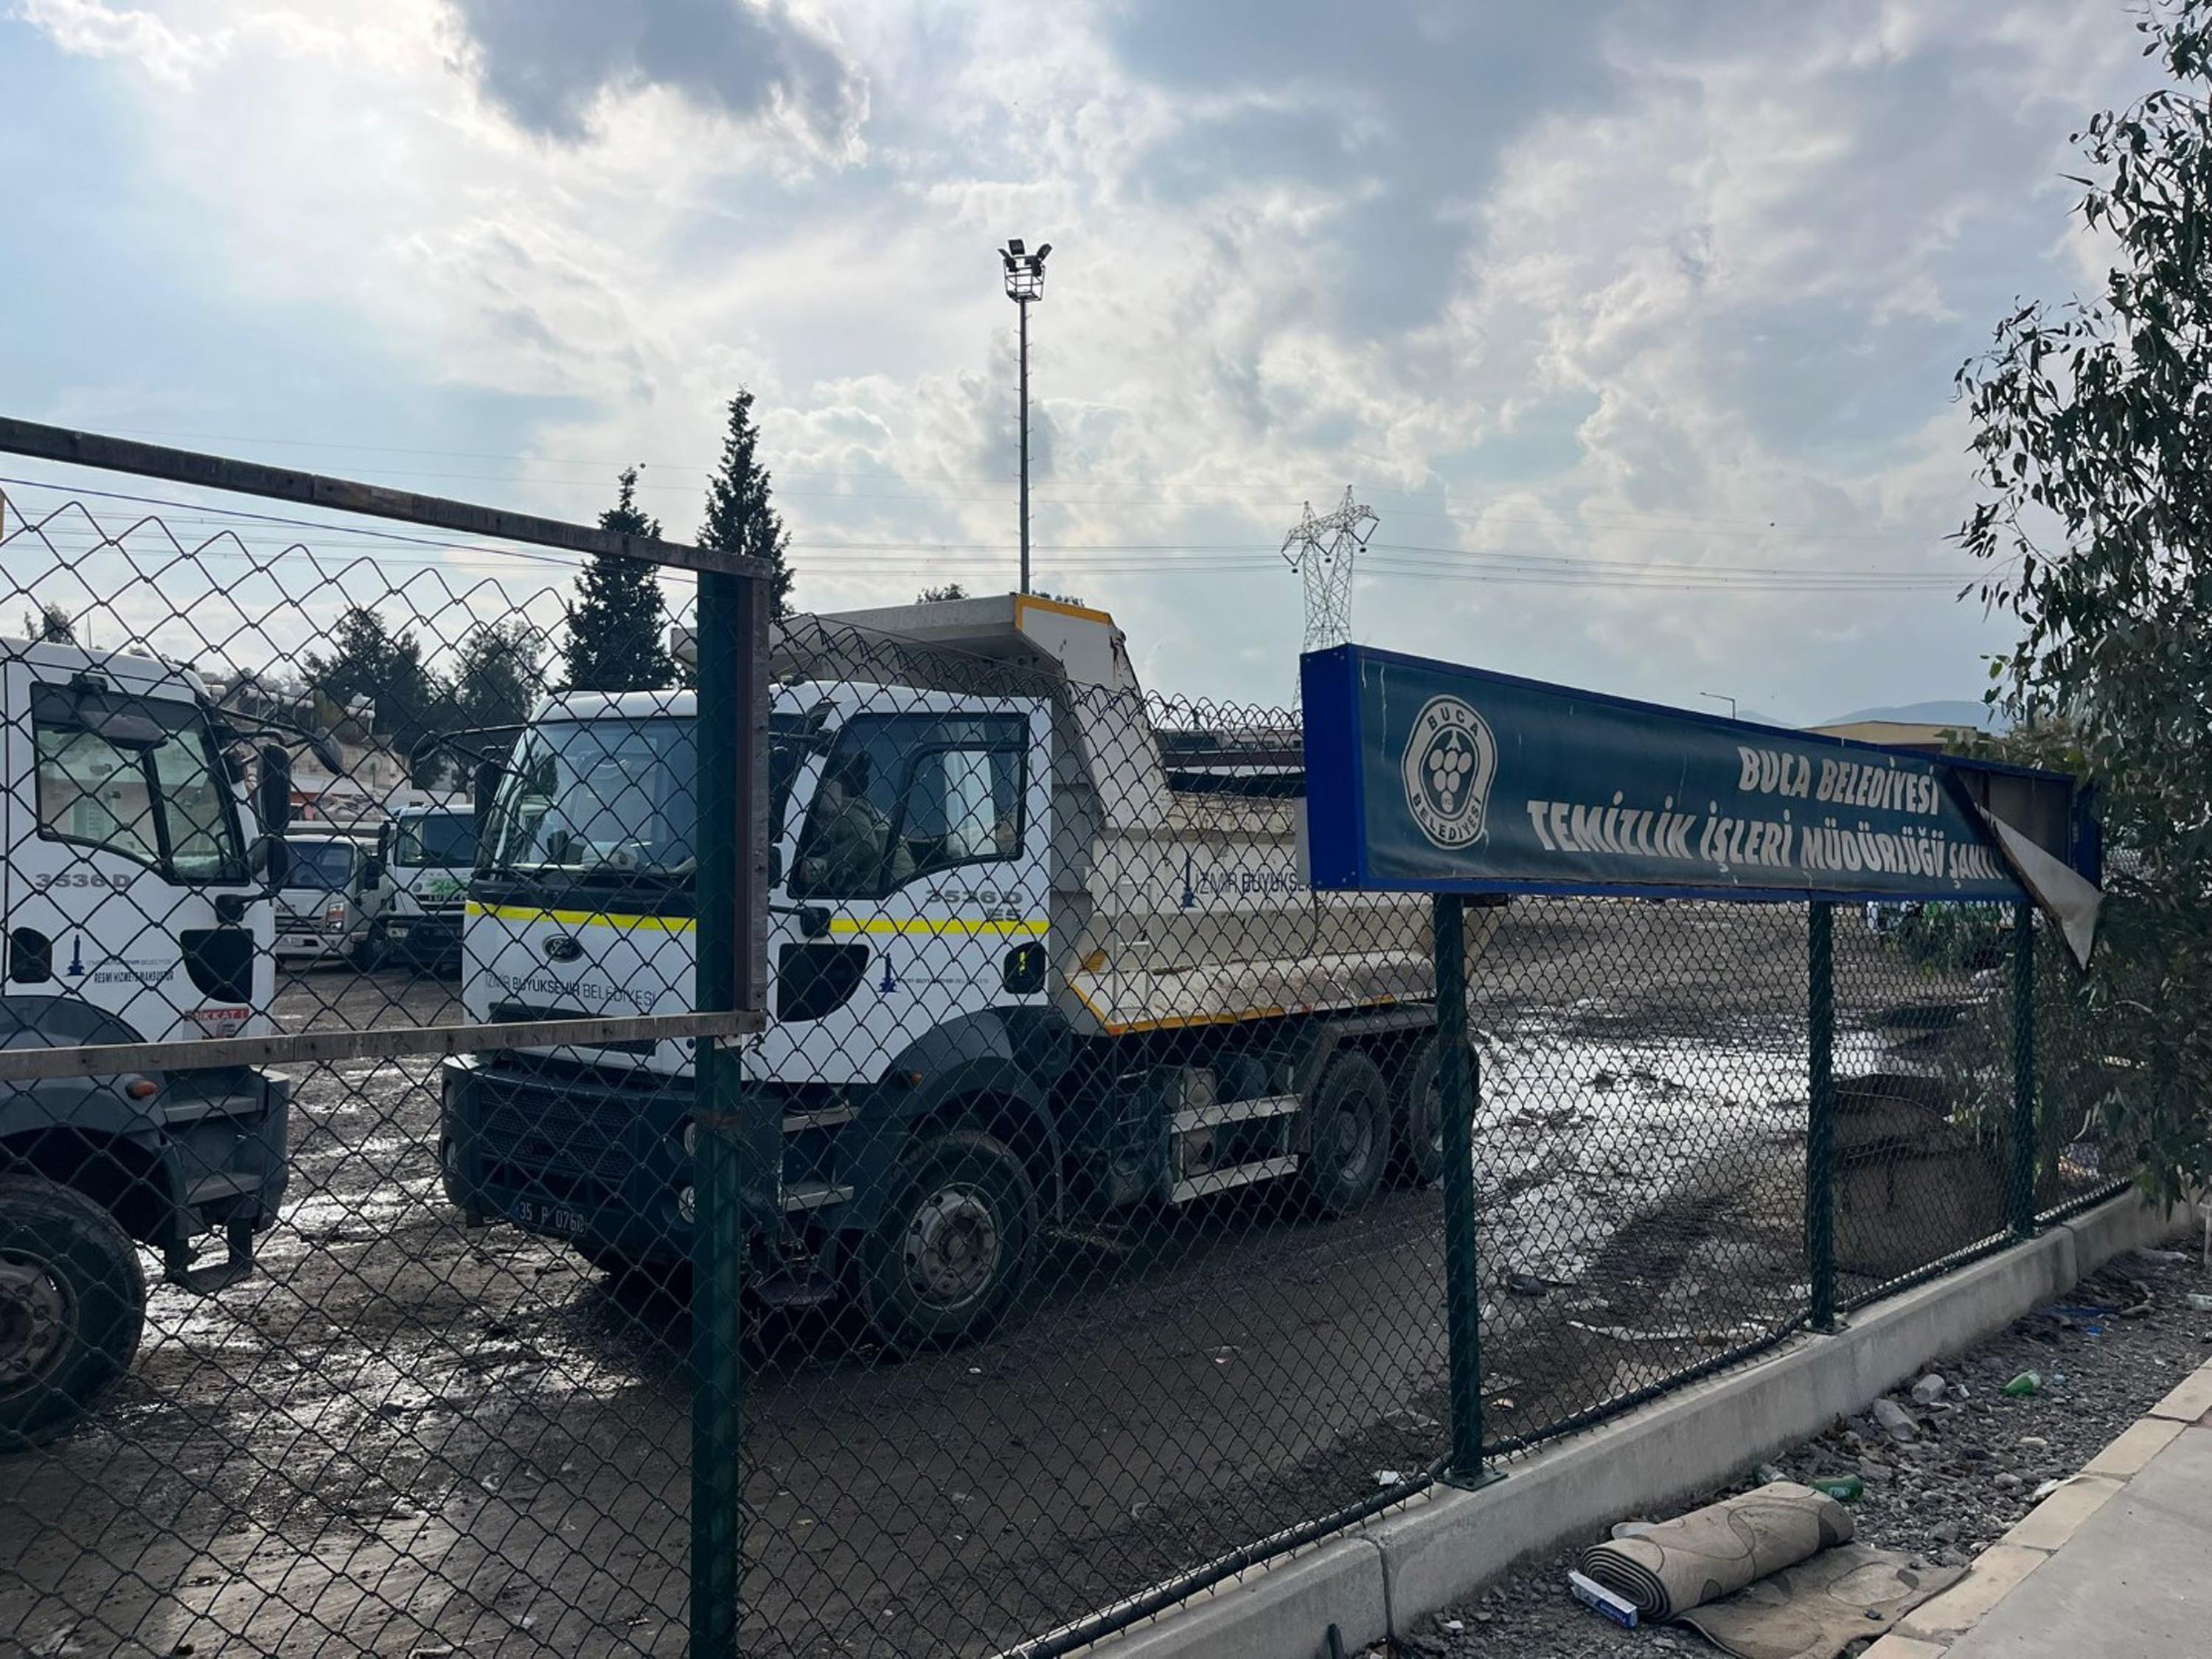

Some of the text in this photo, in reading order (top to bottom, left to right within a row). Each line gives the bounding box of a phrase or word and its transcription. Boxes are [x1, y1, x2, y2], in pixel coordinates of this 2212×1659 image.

[1427, 707, 1479, 737] BUCA
[1736, 745, 1939, 815] BUCA BELEDİYESİ
[1412, 792, 1482, 841] BELEDİYESİ
[1526, 790, 1697, 860] TEMİZLİK
[1700, 799, 1793, 873] İŞLERİ
[1800, 817, 1946, 878] MÜDÜRLÜĞÜ
[35, 873, 132, 887] 3536 D
[925, 889, 1023, 905] 3536 D
[987, 908, 1023, 922] E5
[520, 1200, 533, 1221] 35
